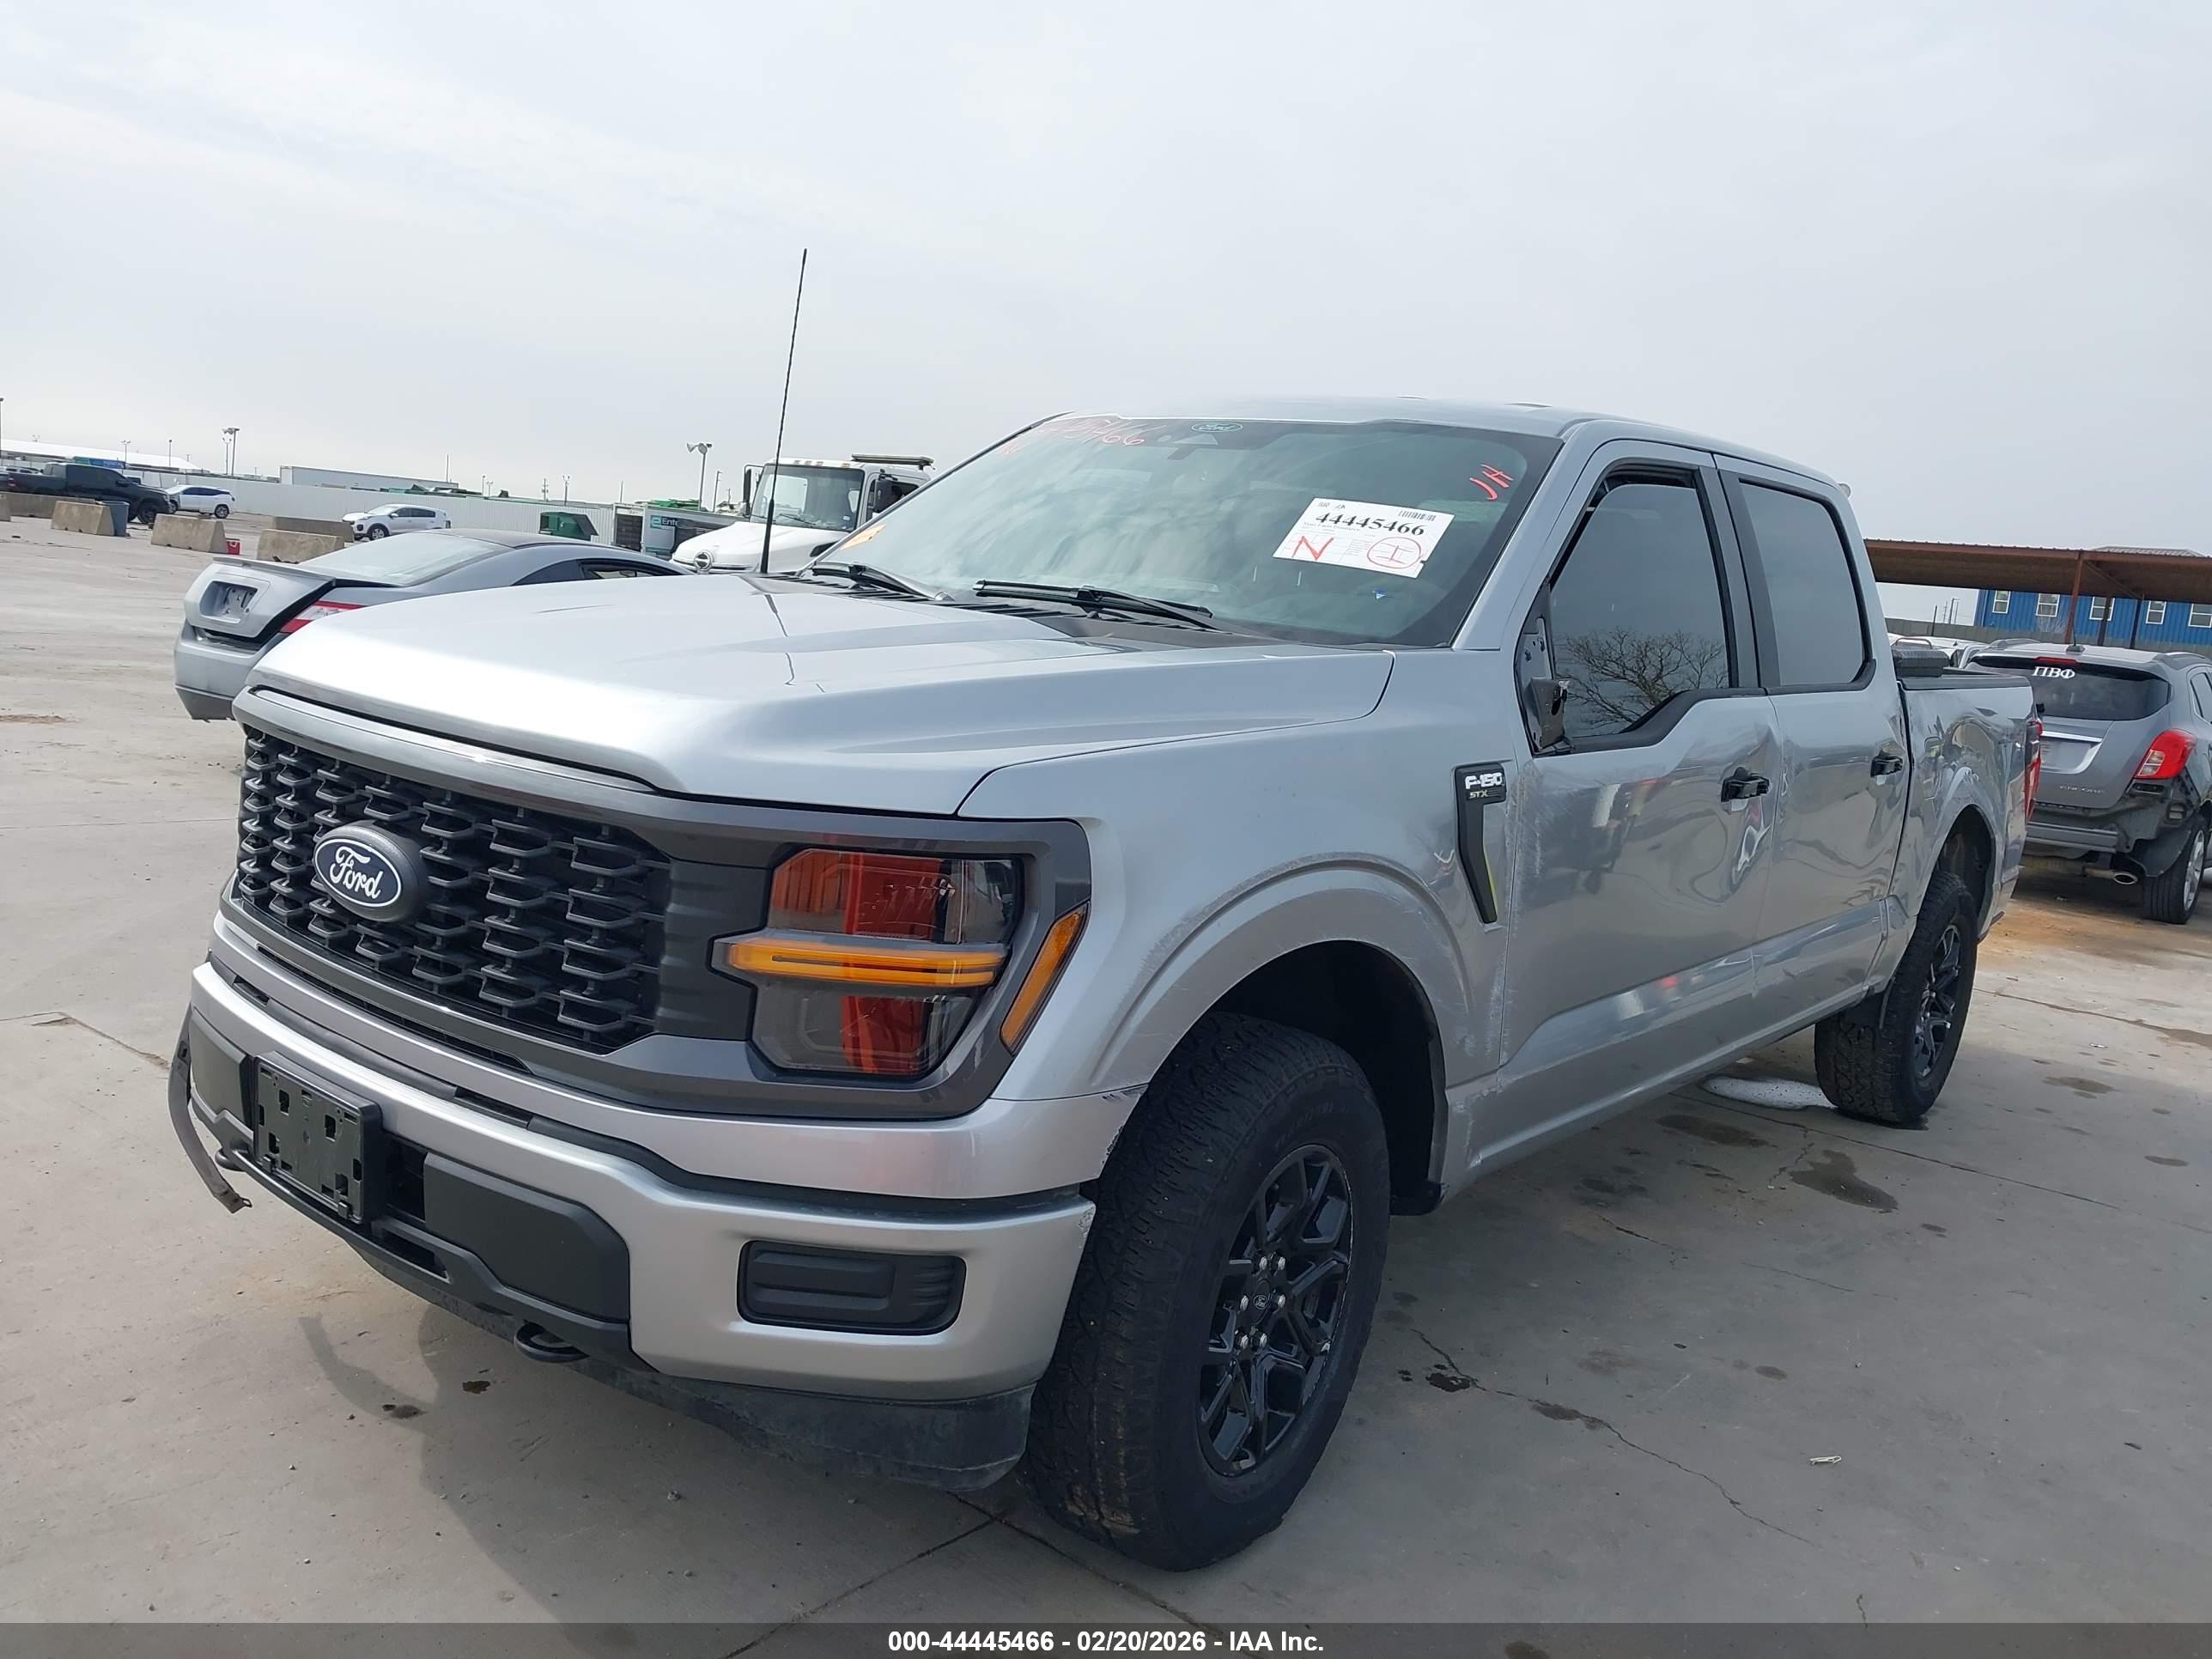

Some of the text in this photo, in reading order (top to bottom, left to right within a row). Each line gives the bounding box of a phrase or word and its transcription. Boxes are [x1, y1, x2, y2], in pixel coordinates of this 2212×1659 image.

[1316, 513, 1428, 537] 44445466
[1291, 535, 1334, 561] N
[1465, 772, 1503, 790] F-150
[1469, 790, 1488, 799] STX
[330, 846, 384, 899] Ford
